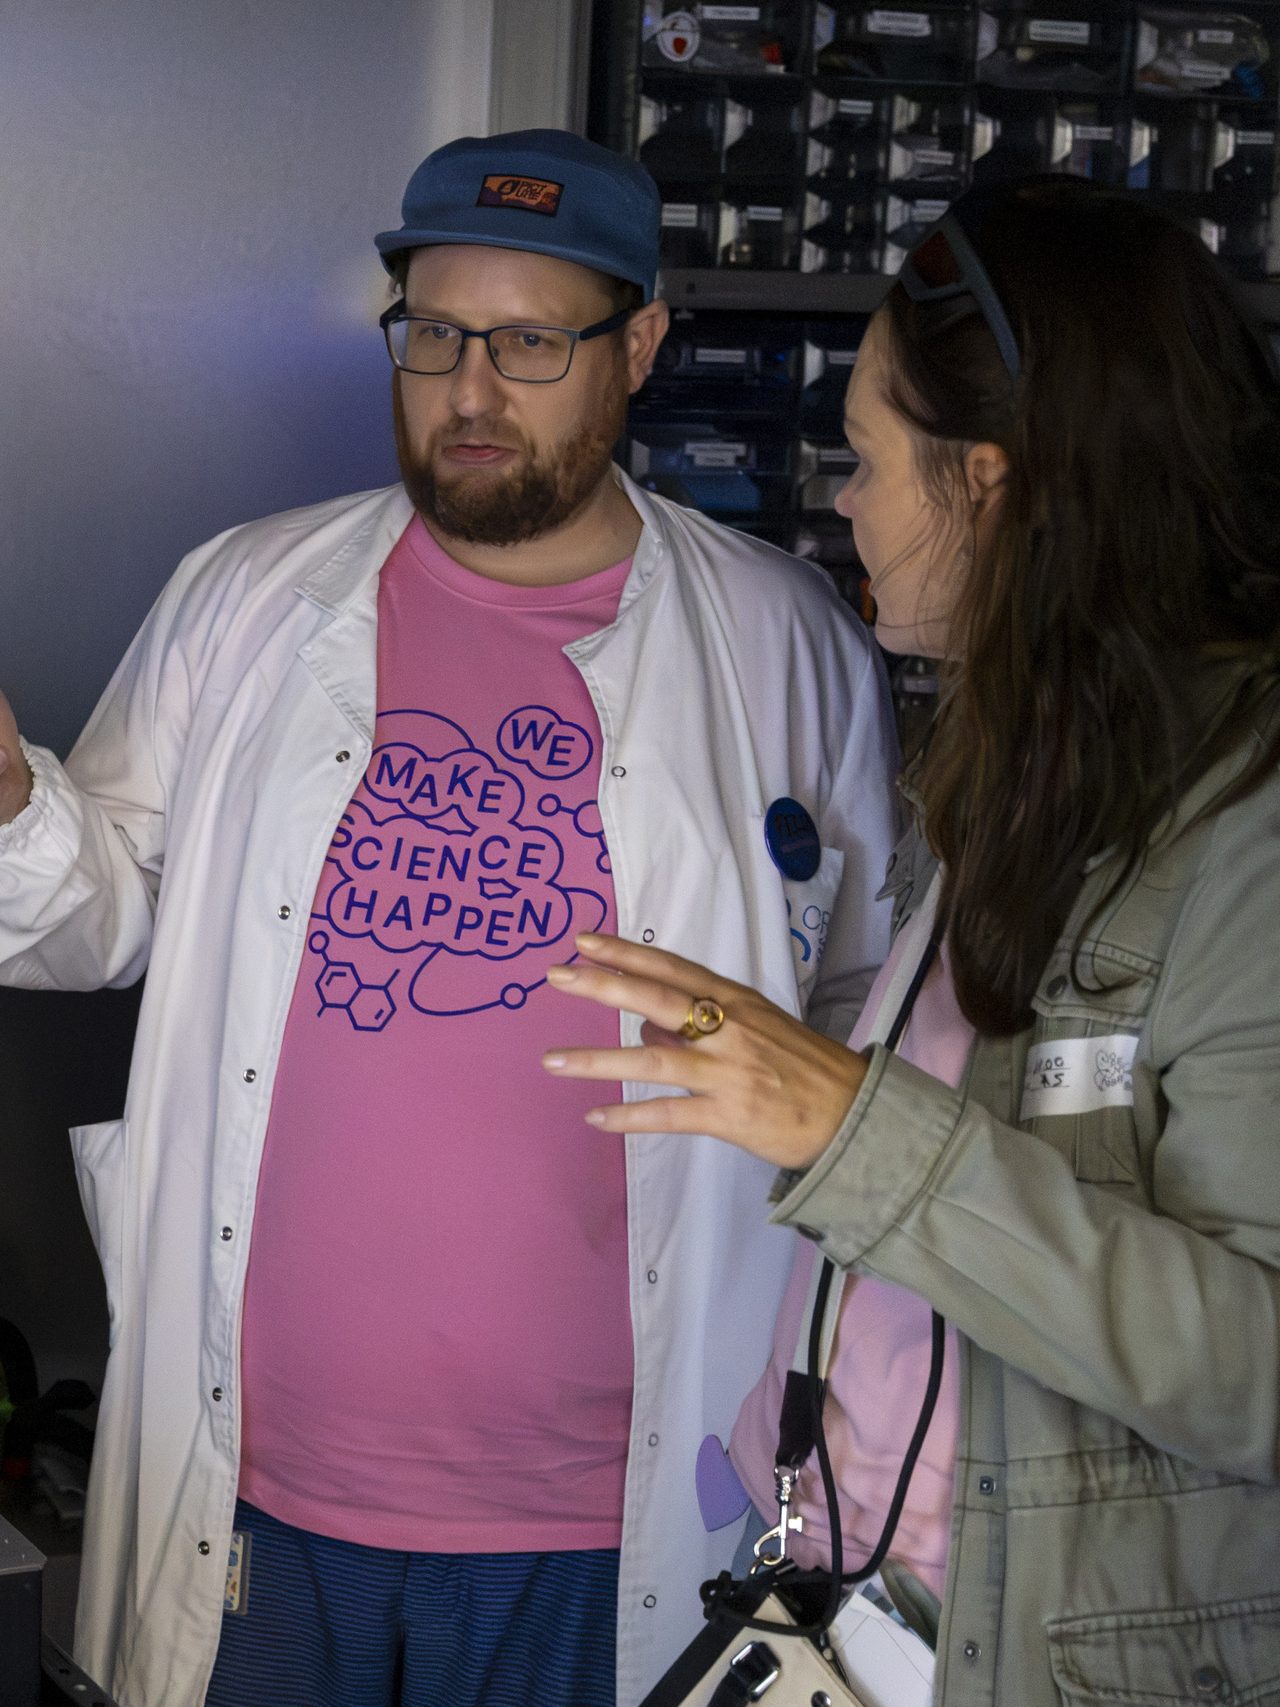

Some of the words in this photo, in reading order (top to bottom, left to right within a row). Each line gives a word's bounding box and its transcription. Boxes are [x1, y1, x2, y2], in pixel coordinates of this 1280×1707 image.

[510, 718, 576, 767] WE
[374, 753, 506, 815] MAKE
[342, 886, 553, 947] HAPPEN
